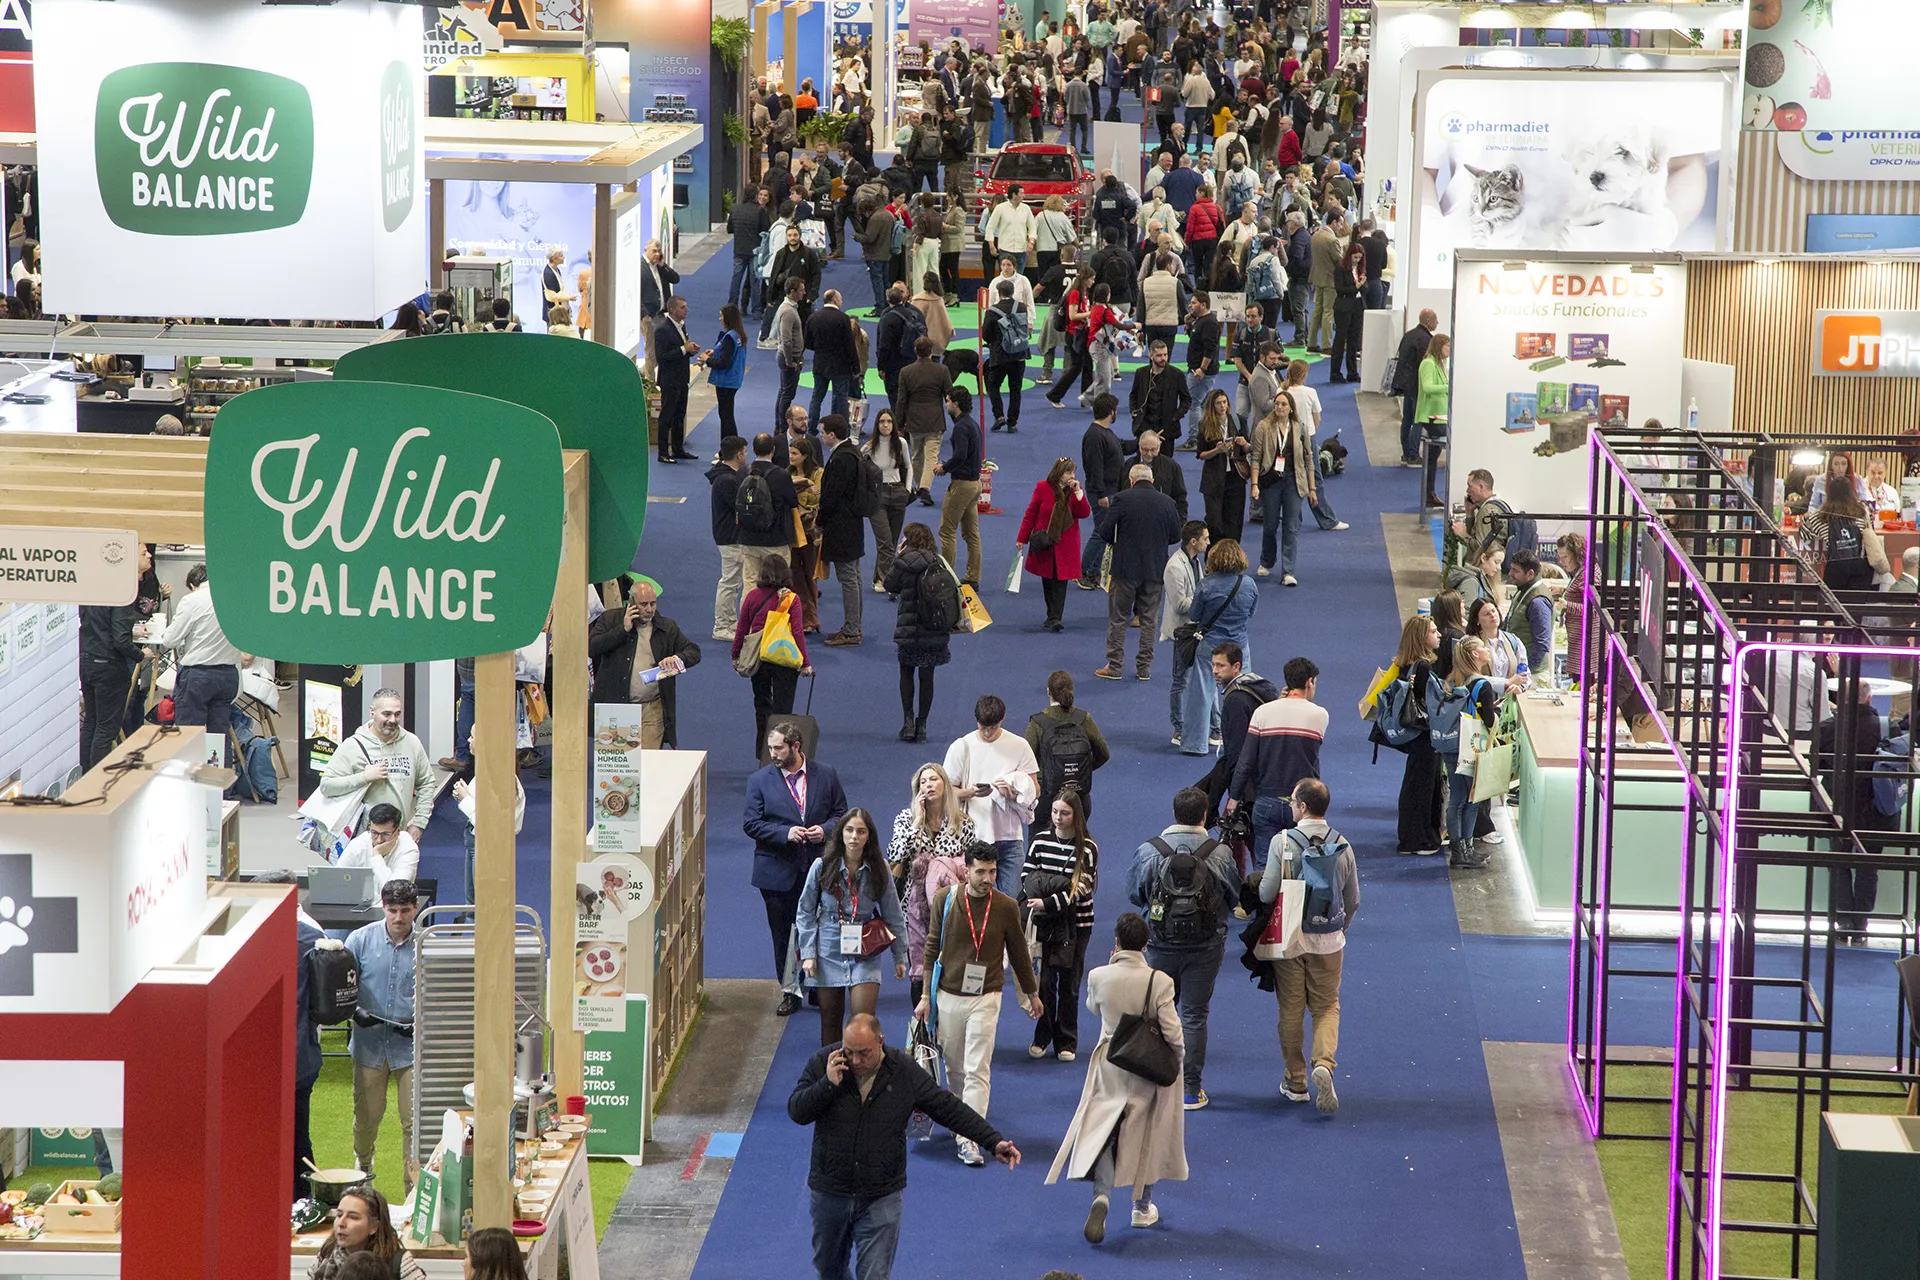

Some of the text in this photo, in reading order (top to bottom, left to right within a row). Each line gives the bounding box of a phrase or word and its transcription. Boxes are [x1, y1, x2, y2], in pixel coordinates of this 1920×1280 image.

[424, 41, 482, 54] nidad
[653, 56, 688, 64] INSECT
[640, 66, 702, 75] SUPERFOOD
[119, 88, 279, 168] Wild
[1466, 120, 1550, 134] pharmadiet
[133, 172, 275, 212] BALANCE
[1479, 274, 1664, 296] NOVEDADES
[1493, 302, 1648, 318] Snacks Funcionales
[1839, 336, 1880, 366] JT
[251, 427, 505, 552] Wild
[23, 548, 77, 563] VAPOR
[270, 561, 496, 622] BALANCE
[584, 1051, 612, 1061] IERES
